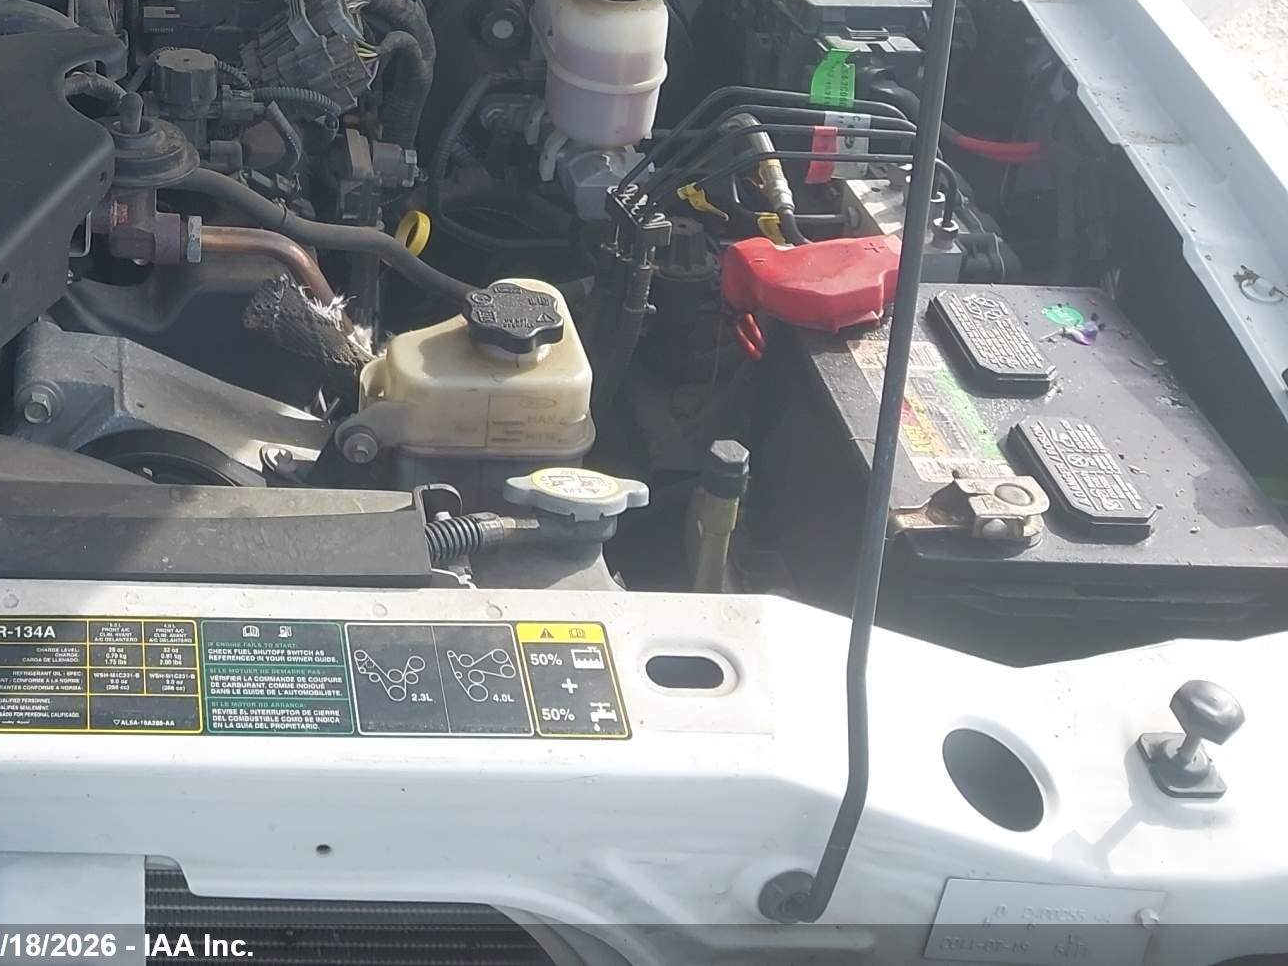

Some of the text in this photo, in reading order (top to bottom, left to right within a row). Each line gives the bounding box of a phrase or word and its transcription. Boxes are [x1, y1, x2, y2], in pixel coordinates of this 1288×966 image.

[530, 653, 563, 666] 50%
[411, 693, 433, 702] 2.3L
[492, 693, 515, 702] 4.0L
[227, 715, 280, 723] COMBUSTIBLE
[541, 708, 576, 721] 50%
